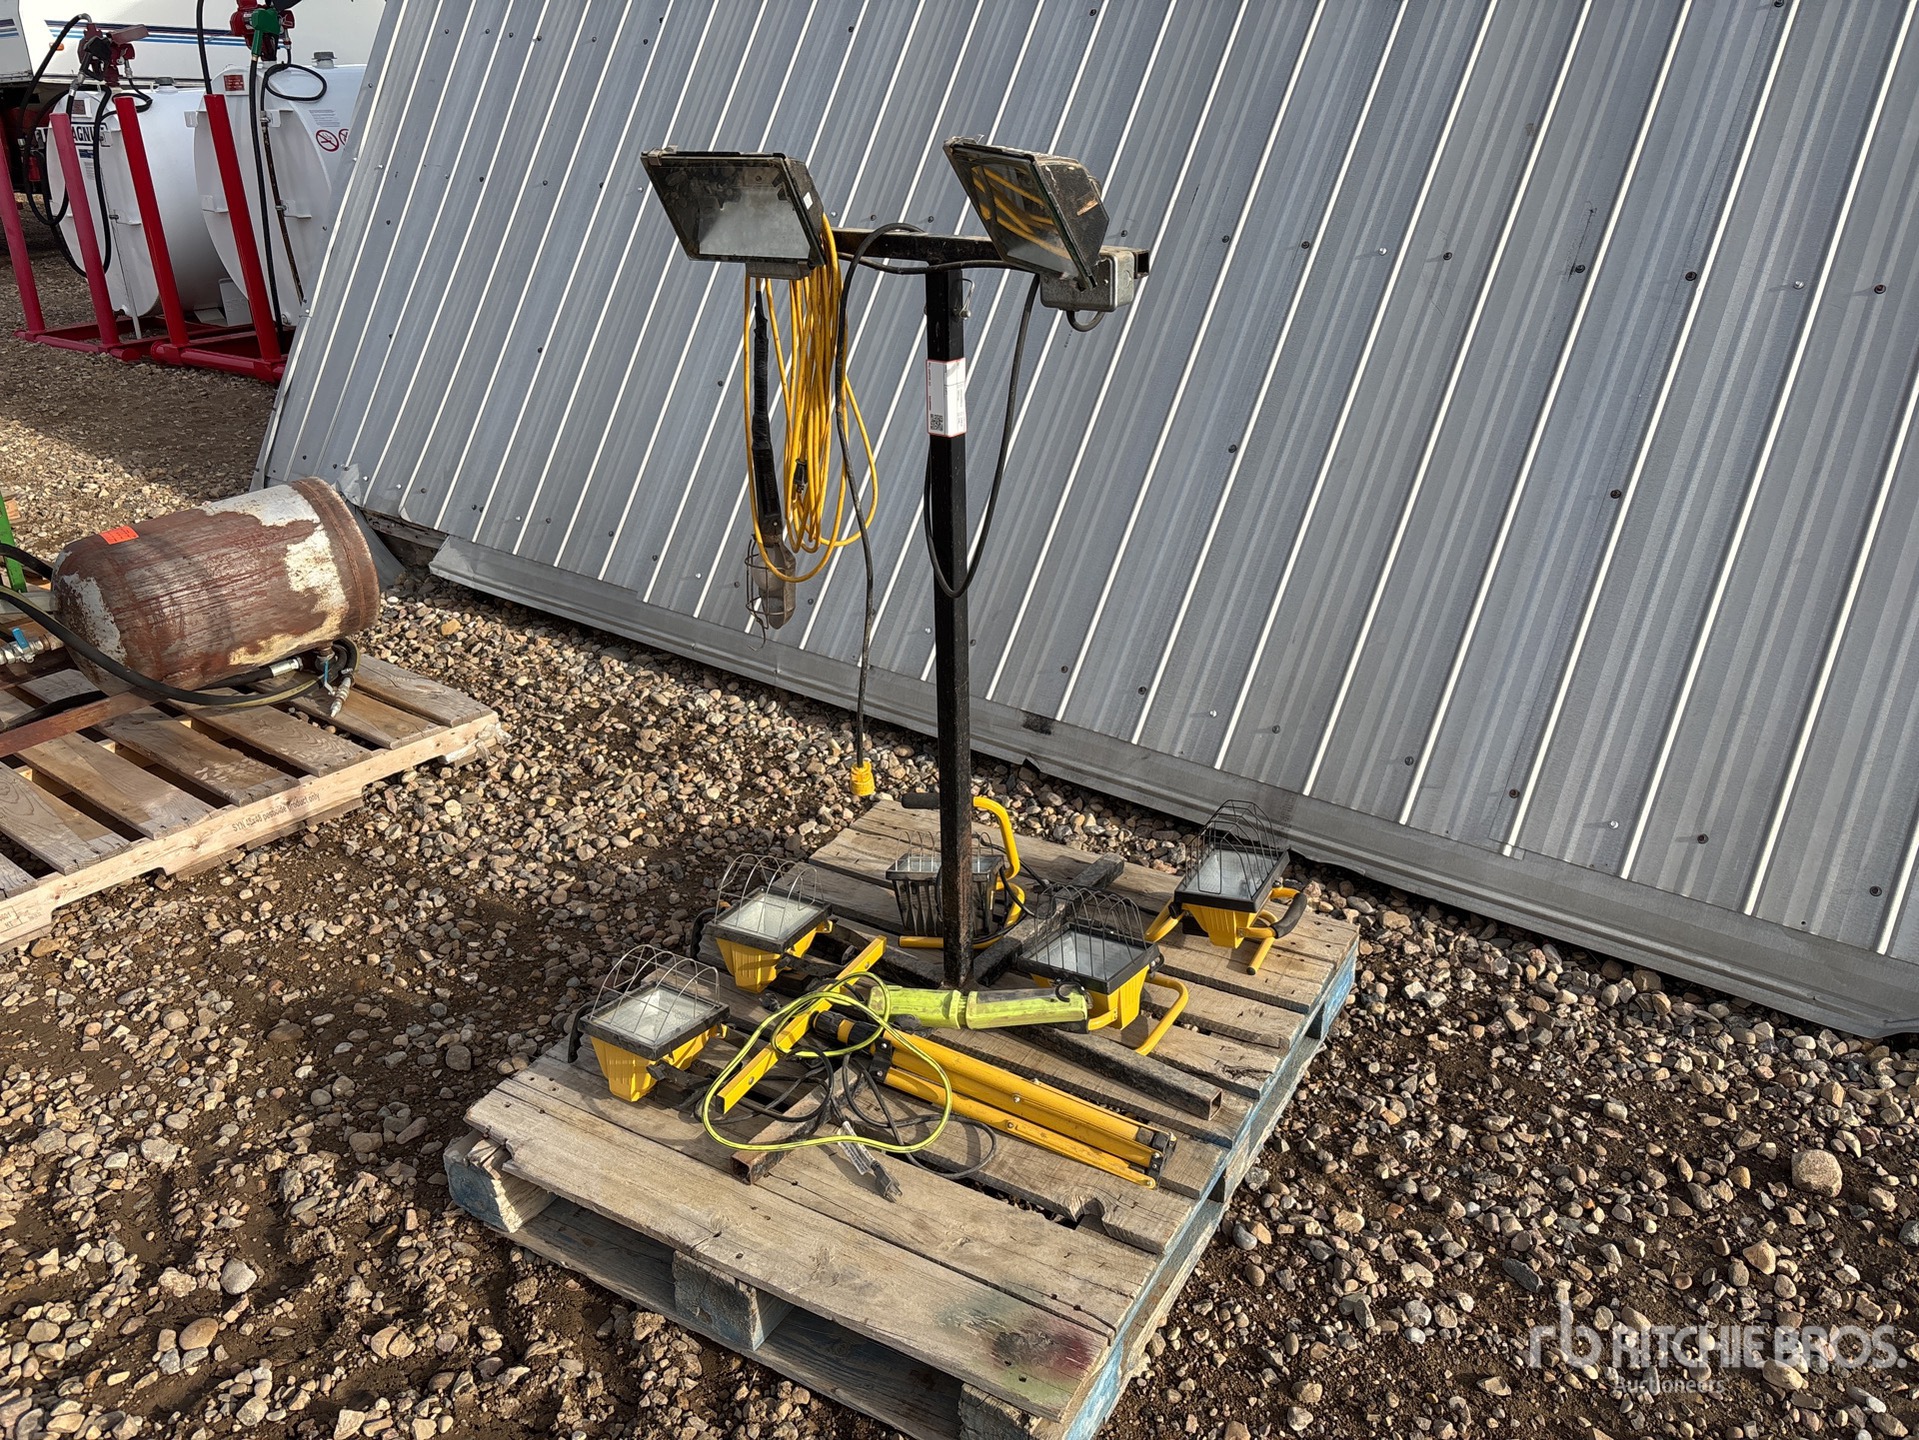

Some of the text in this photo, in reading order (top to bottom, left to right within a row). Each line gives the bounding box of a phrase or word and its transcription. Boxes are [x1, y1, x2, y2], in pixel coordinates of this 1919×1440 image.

[231, 819, 246, 832] SYN
[288, 796, 309, 812] product
[308, 792, 321, 803] only
